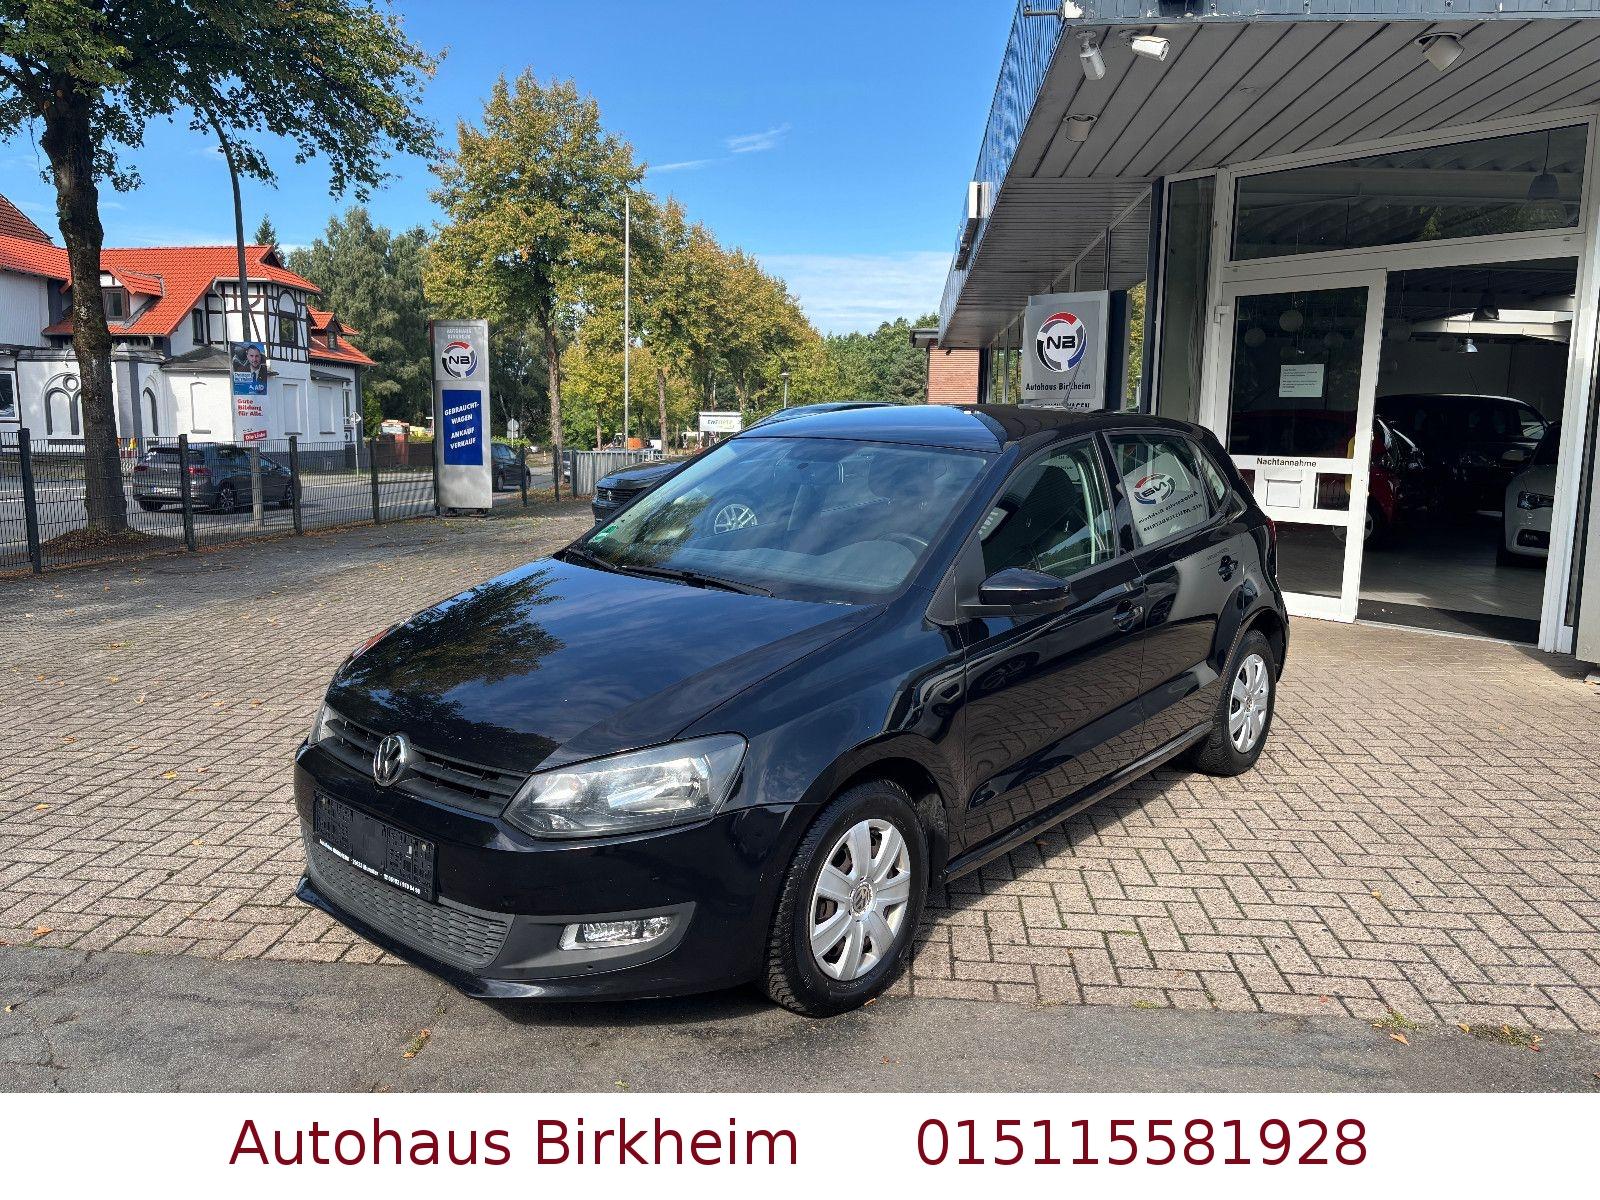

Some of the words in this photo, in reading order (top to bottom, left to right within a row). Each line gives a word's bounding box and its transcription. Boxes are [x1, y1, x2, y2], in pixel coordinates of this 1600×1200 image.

[1046, 335, 1076, 349] NB
[449, 355, 470, 364] NB
[1025, 382, 1057, 391] Autohaus
[444, 401, 480, 416] GEBRAUCHT-
[451, 414, 473, 425] WAGEN
[450, 426, 475, 439] ANKAUF
[450, 437, 477, 450] VERKAUF
[1256, 457, 1317, 468] Nachtannahme
